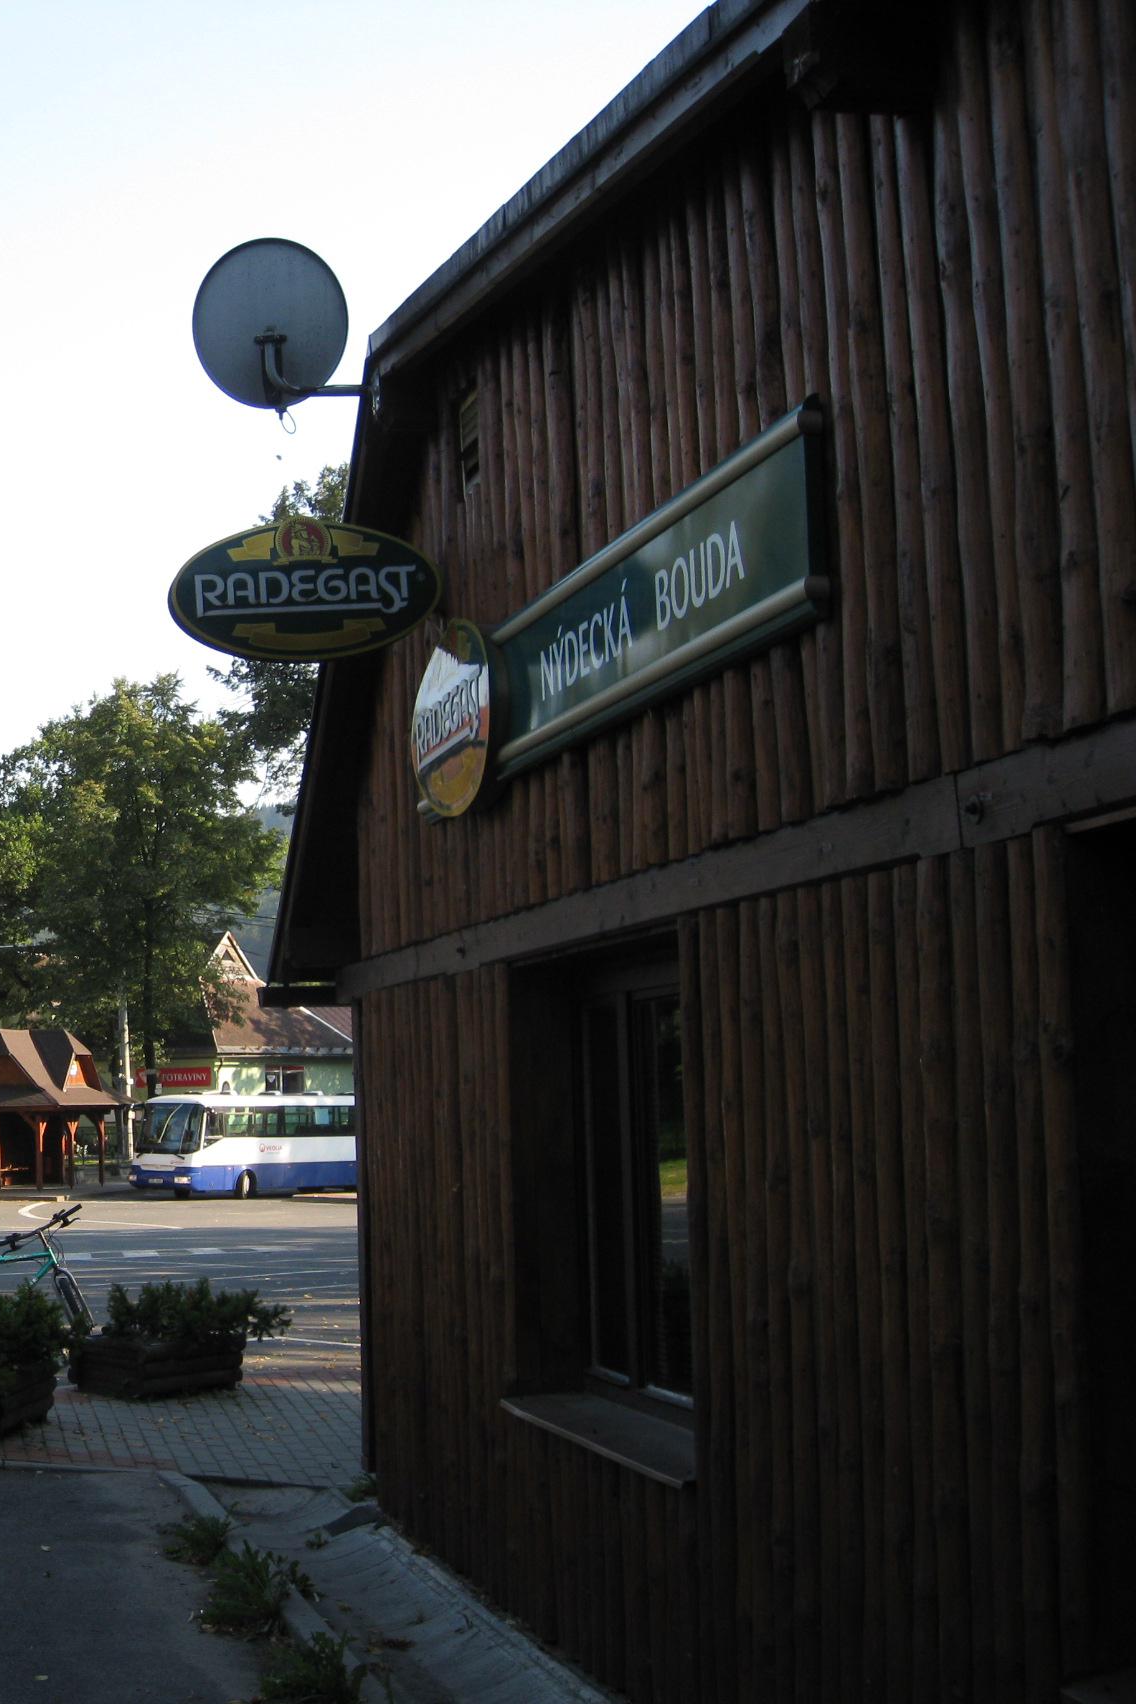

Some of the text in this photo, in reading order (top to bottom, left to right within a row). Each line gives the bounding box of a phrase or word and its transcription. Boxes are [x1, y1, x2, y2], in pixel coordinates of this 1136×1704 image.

[194, 565, 416, 618] RADEGAST
[540, 520, 745, 701] NÝDECKÁ BOUDA
[417, 664, 481, 771] RADEGAST
